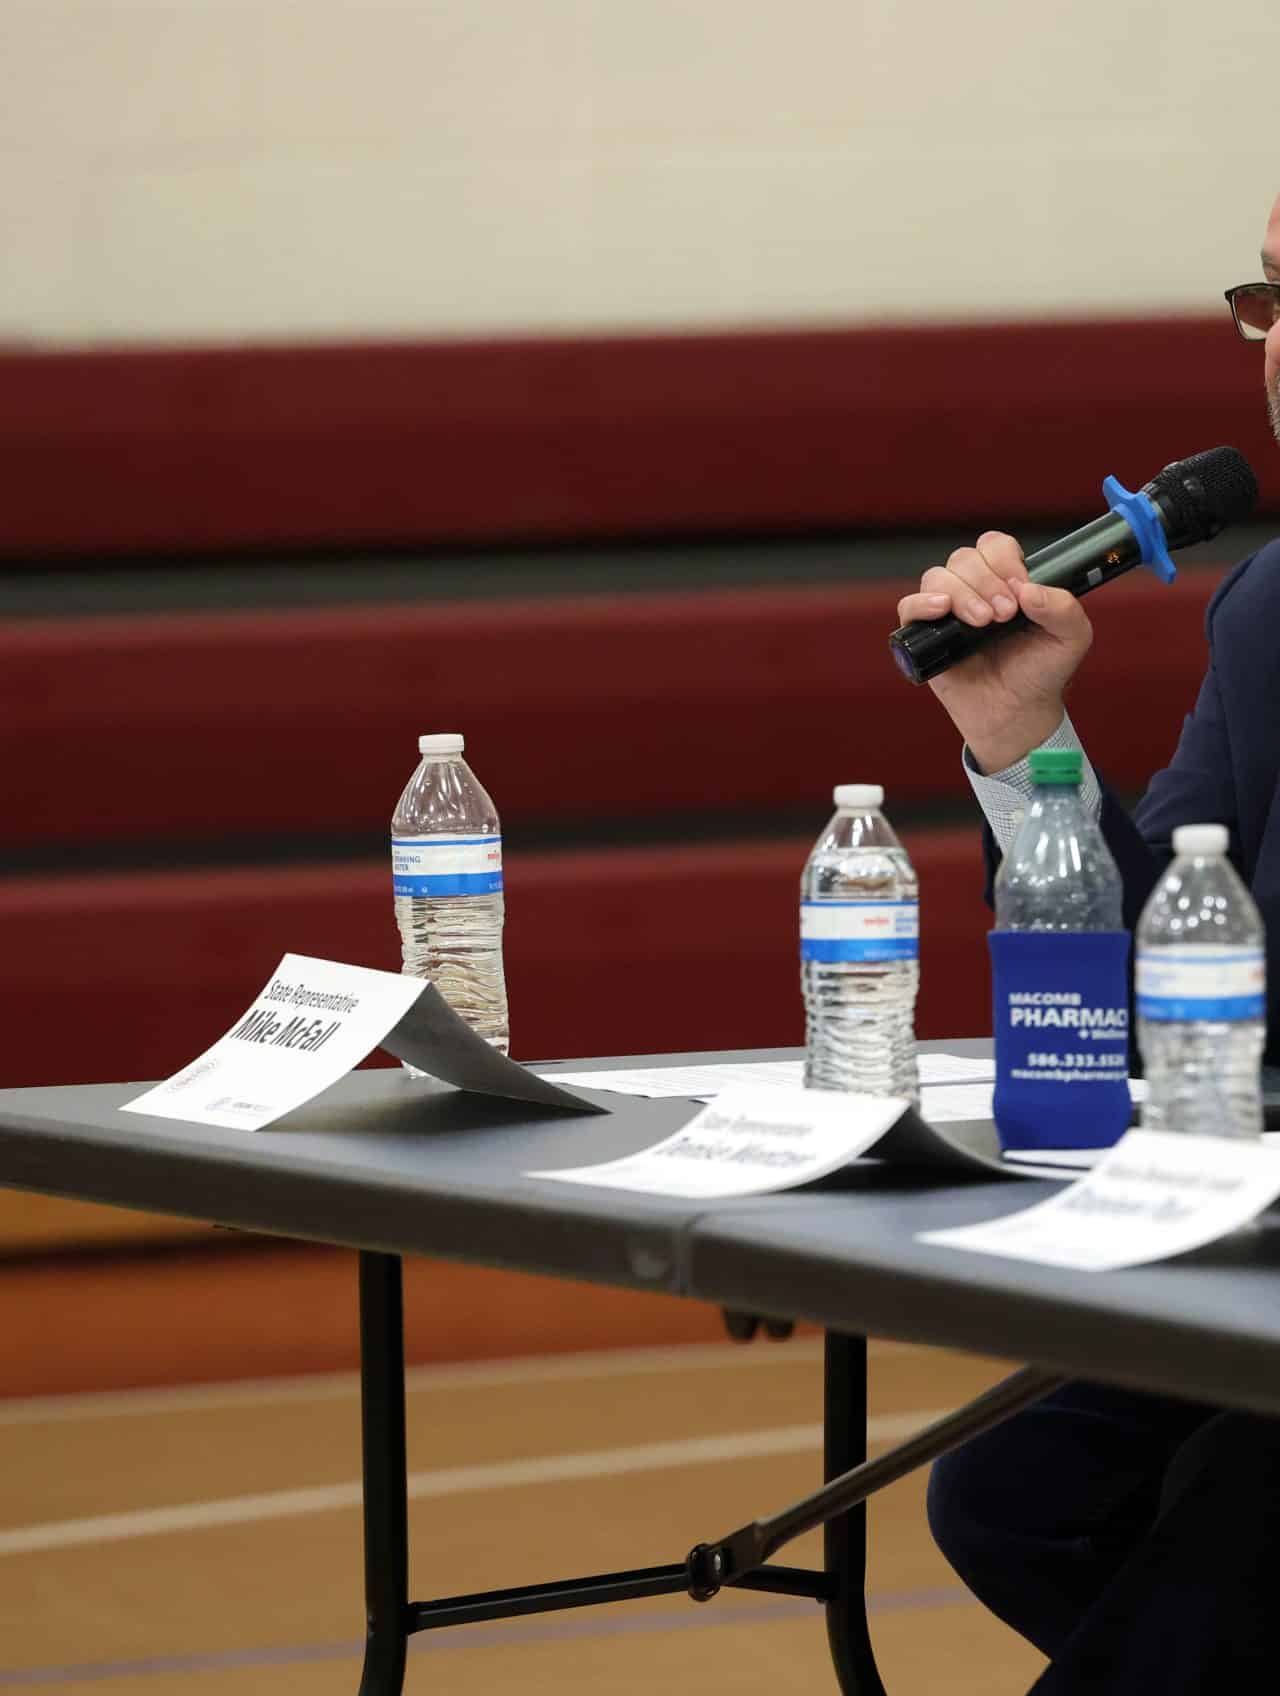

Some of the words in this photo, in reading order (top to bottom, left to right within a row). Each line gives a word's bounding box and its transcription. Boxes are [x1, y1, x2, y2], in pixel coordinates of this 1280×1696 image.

[264, 979, 293, 1003] State
[289, 984, 360, 1014] Representative
[1008, 992, 1081, 1006] MACOMB
[230, 1009, 281, 1043] Mike
[270, 1016, 342, 1052] McFall
